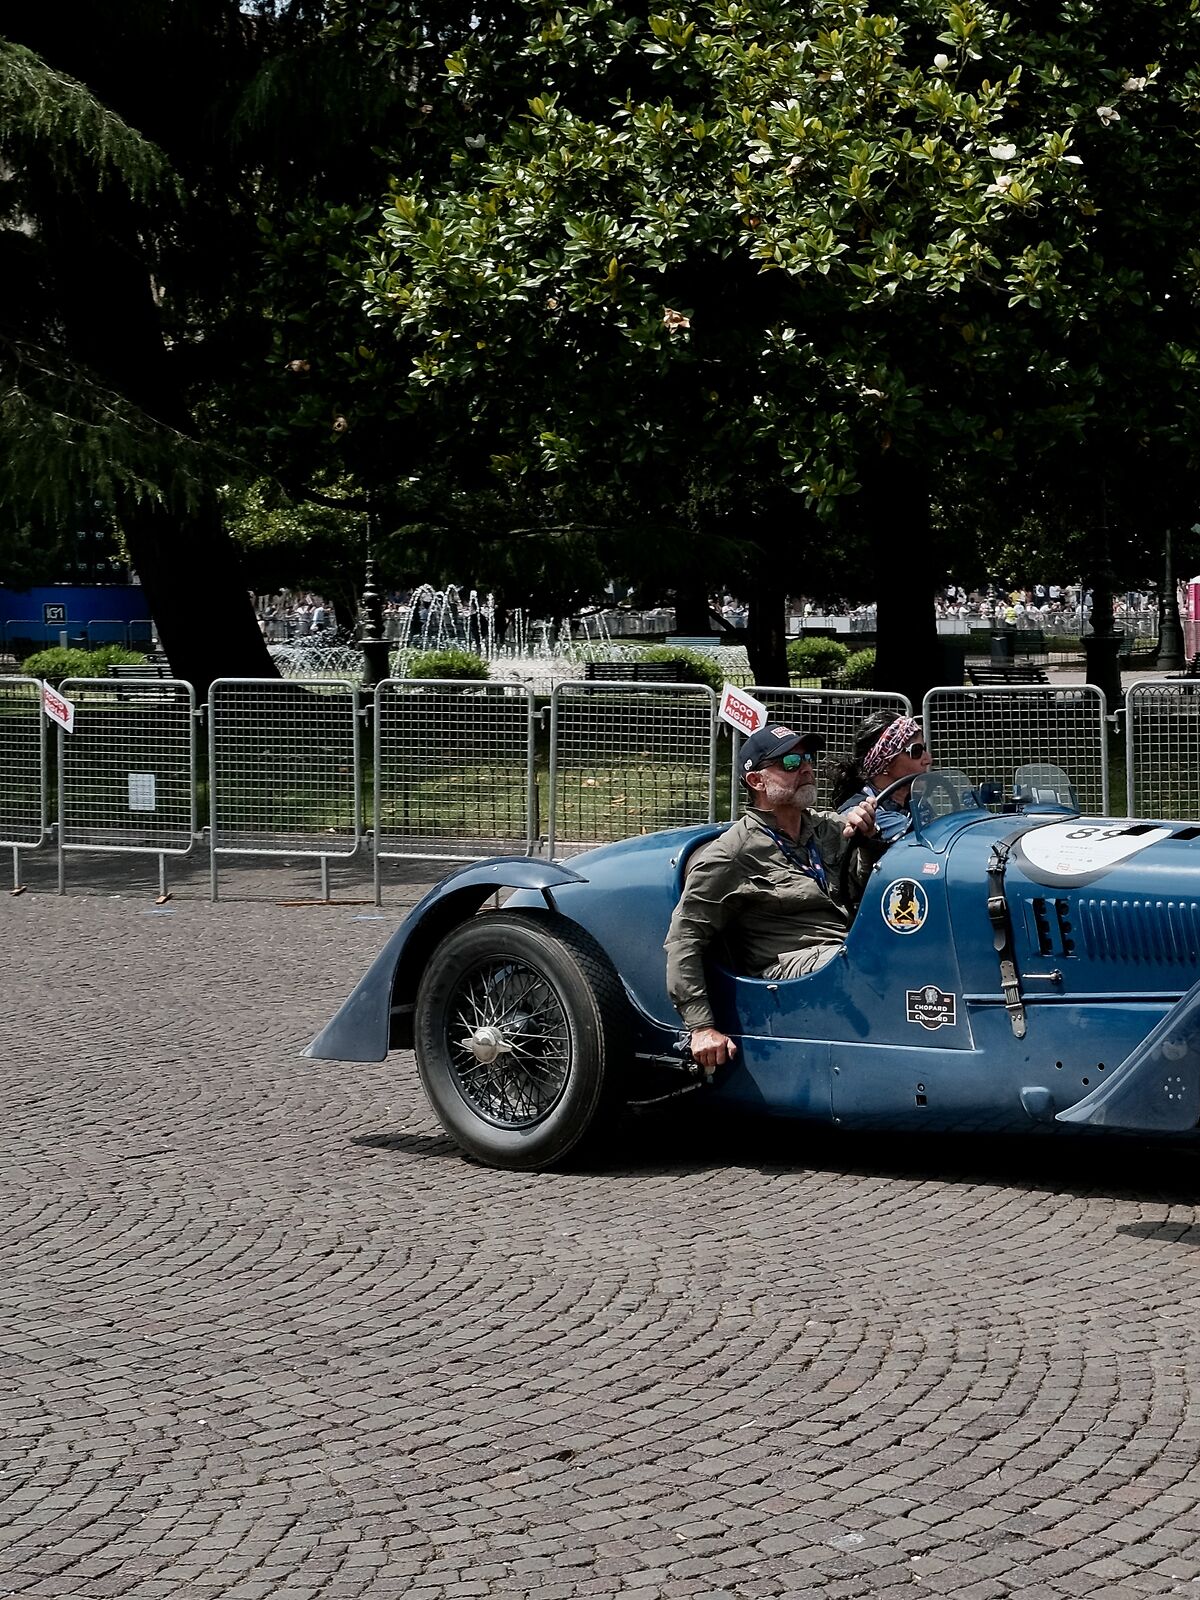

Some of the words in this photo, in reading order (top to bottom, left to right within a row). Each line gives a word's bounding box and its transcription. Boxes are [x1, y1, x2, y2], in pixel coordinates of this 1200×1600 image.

[725, 706, 753, 729] MIGLIA
[729, 697, 754, 718] 1000
[914, 1004, 948, 1012] CHOPARD
